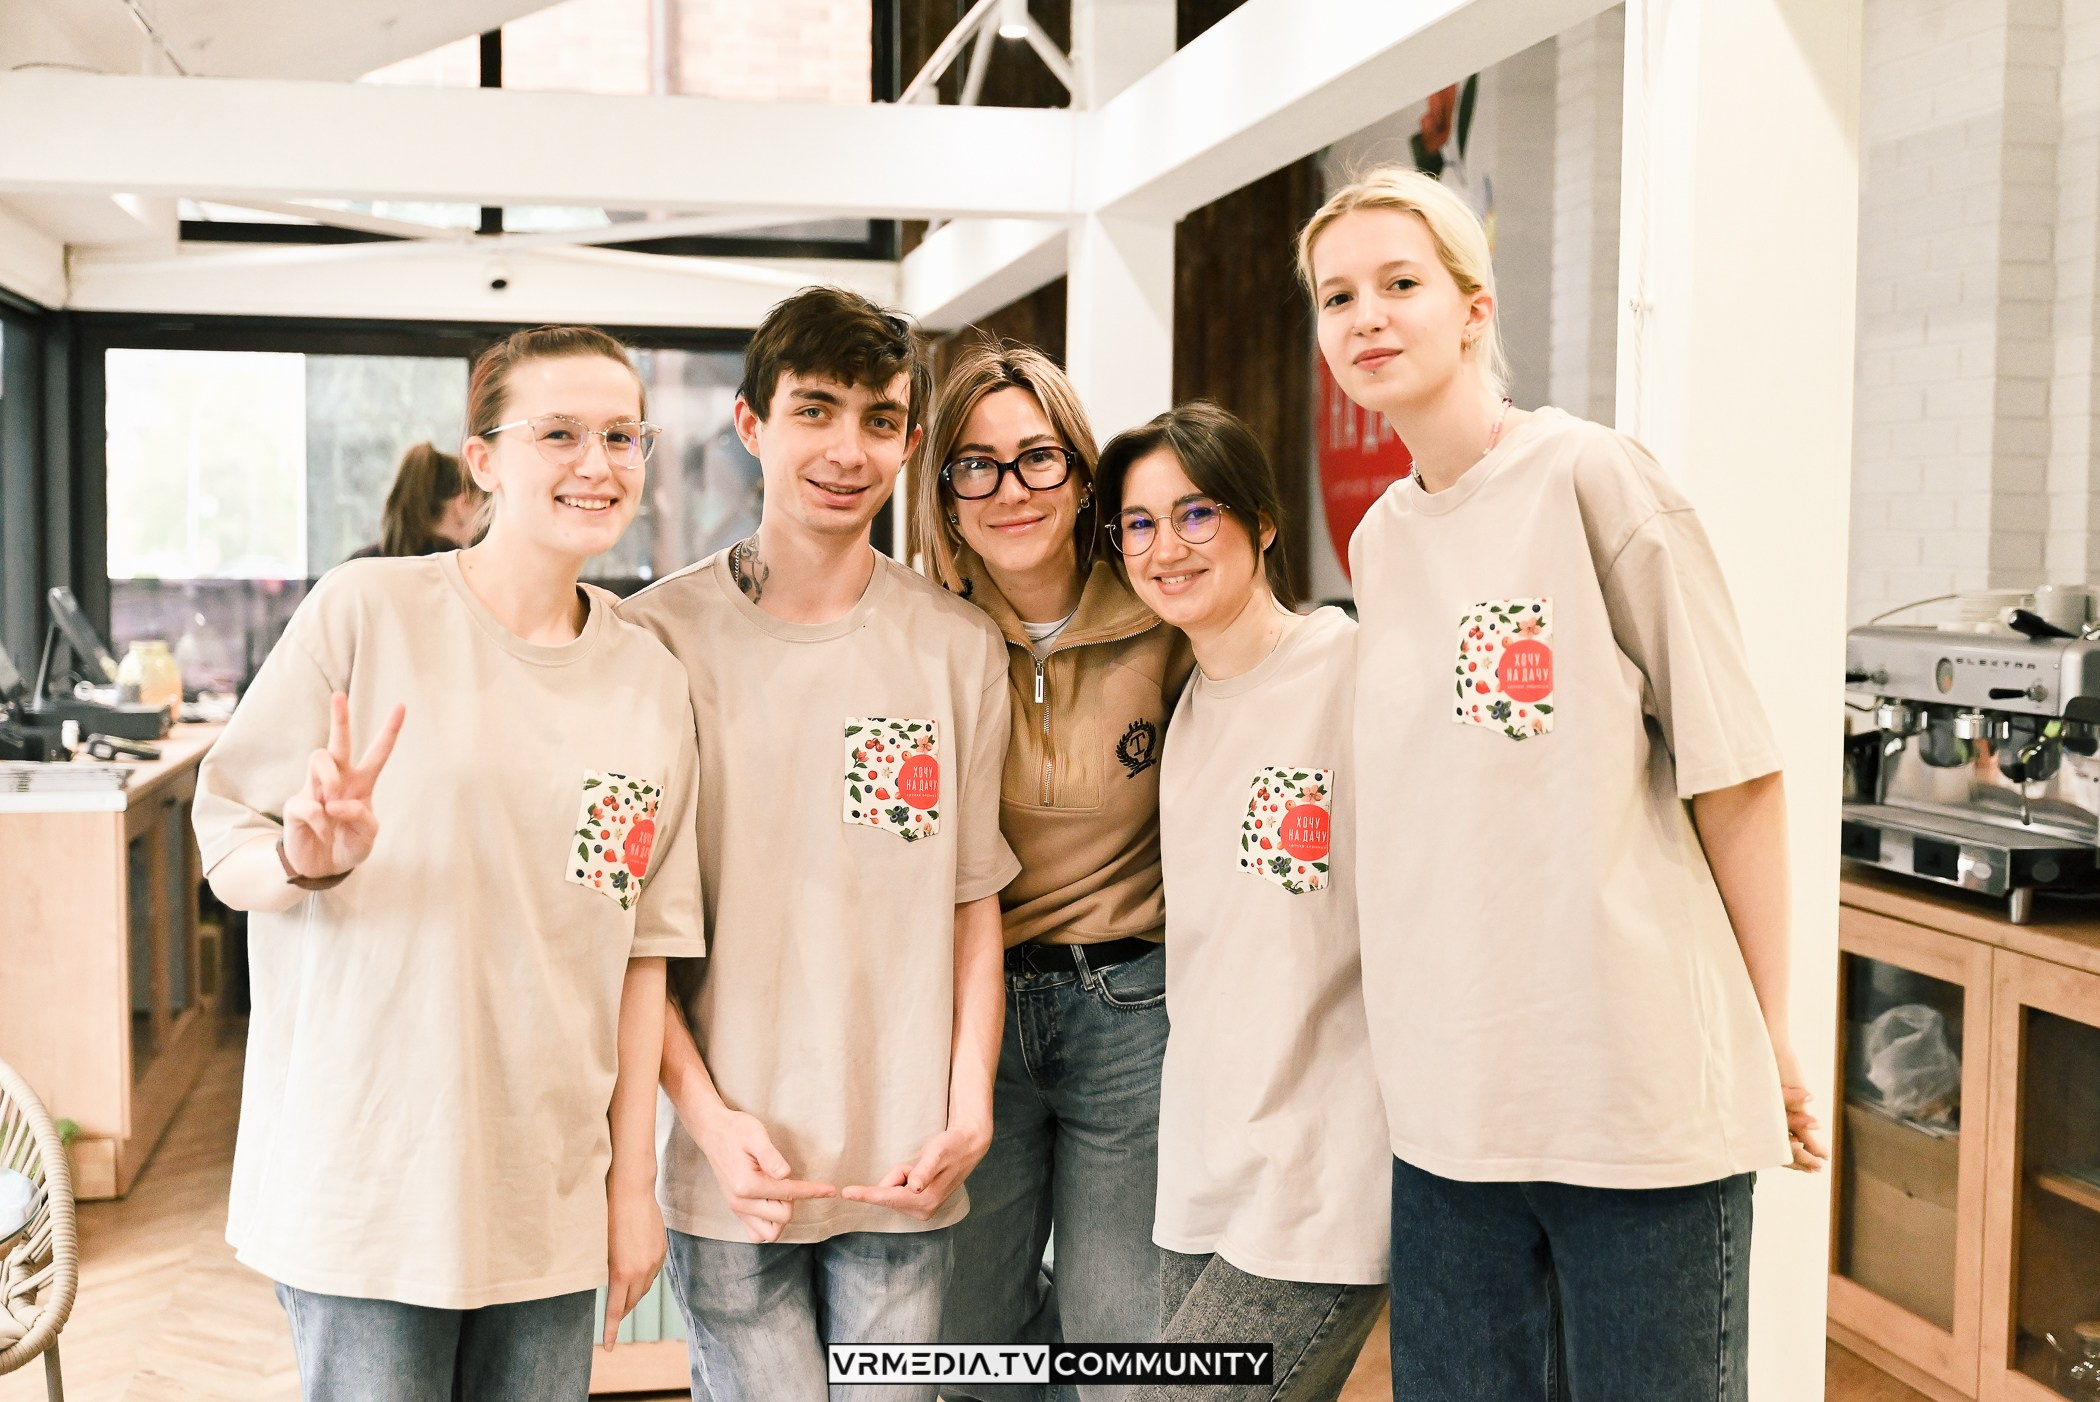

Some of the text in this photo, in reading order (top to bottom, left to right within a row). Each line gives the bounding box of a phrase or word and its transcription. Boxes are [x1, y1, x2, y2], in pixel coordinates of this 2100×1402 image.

[1514, 652, 1541, 667] ХОЧУ
[1955, 657, 2036, 670] ELEKTRA
[1506, 667, 1549, 683] НА ДАЧУ
[913, 766, 933, 778] ХОЧУ
[906, 778, 938, 792] НА ДАЧУ
[1296, 816, 1321, 829] ХОЧУ
[1288, 828, 1327, 843] НА ДАЧУ
